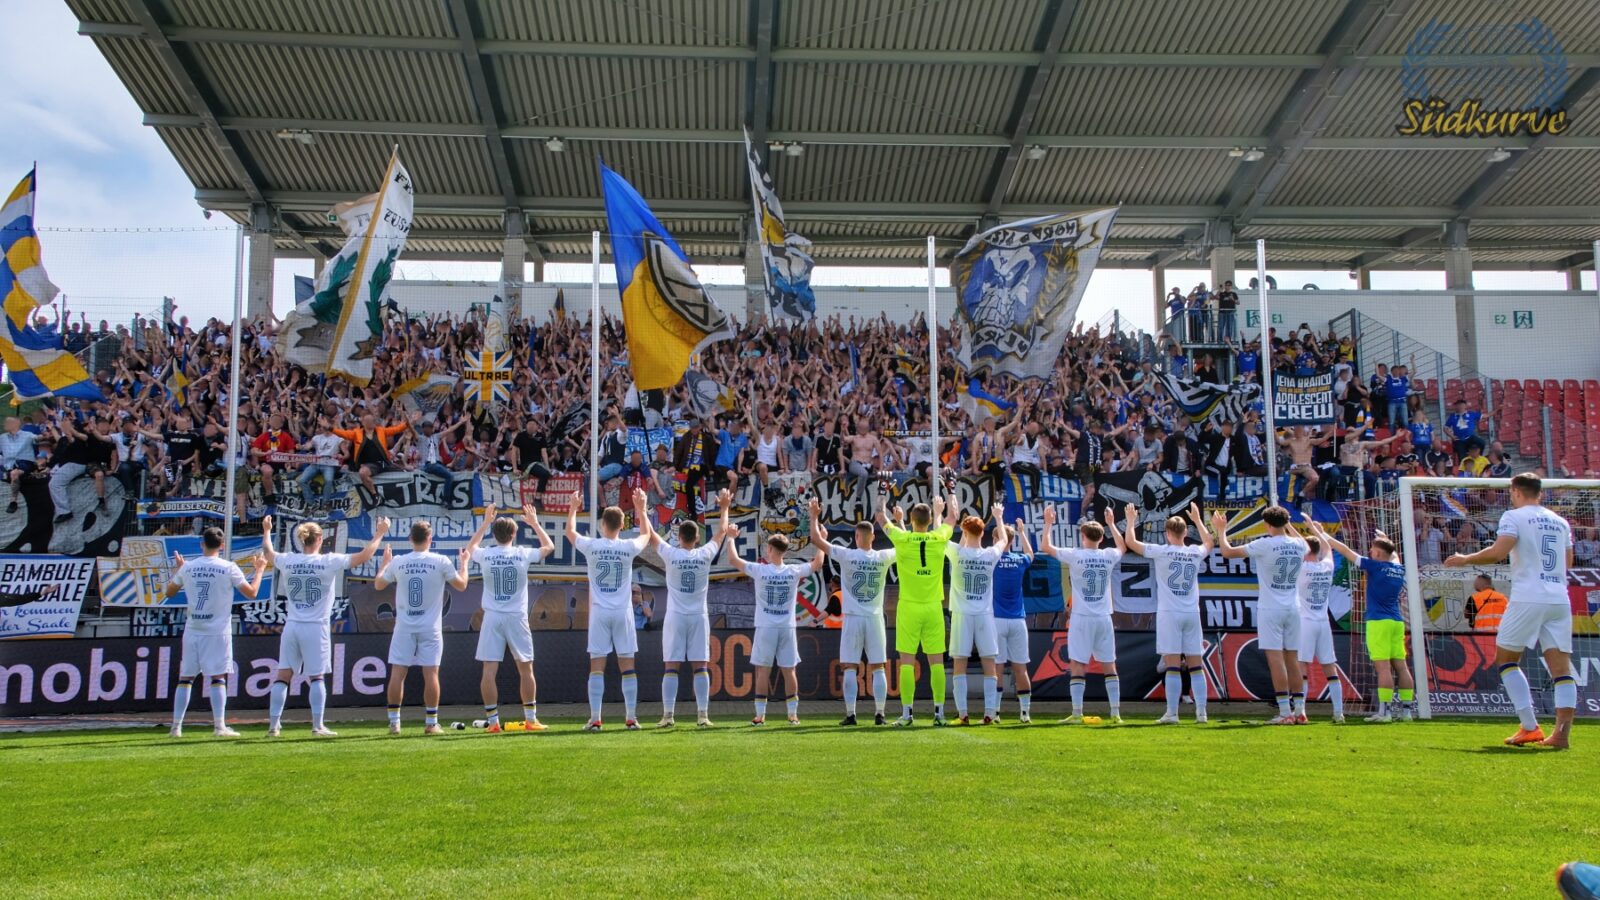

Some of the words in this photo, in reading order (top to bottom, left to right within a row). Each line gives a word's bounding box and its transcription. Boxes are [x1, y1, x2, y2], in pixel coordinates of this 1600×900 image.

[1272, 313, 1284, 324] E1
[1494, 314, 1507, 325] E2
[464, 371, 510, 381] ULTRAS
[1276, 390, 1333, 405] ADOLESCENT
[1274, 403, 1333, 420] CREW
[522, 478, 581, 492] SCCKERIA
[1538, 524, 1562, 533] JENA
[919, 541, 927, 567] 1
[1541, 534, 1557, 571] 5
[2, 563, 91, 582] BAMBULE
[490, 566, 518, 596] 18
[595, 561, 623, 588] 21
[1167, 561, 1197, 591] 29
[1273, 556, 1301, 584] 32
[287, 577, 322, 604] 26
[408, 577, 423, 607] 8
[680, 571, 696, 593] 9
[851, 571, 881, 600] 25
[963, 572, 988, 595] 16
[195, 581, 210, 610] 7
[15, 605, 75, 618] kommen
[27, 617, 71, 632] Saale
[1457, 706, 1485, 714] WERKE
